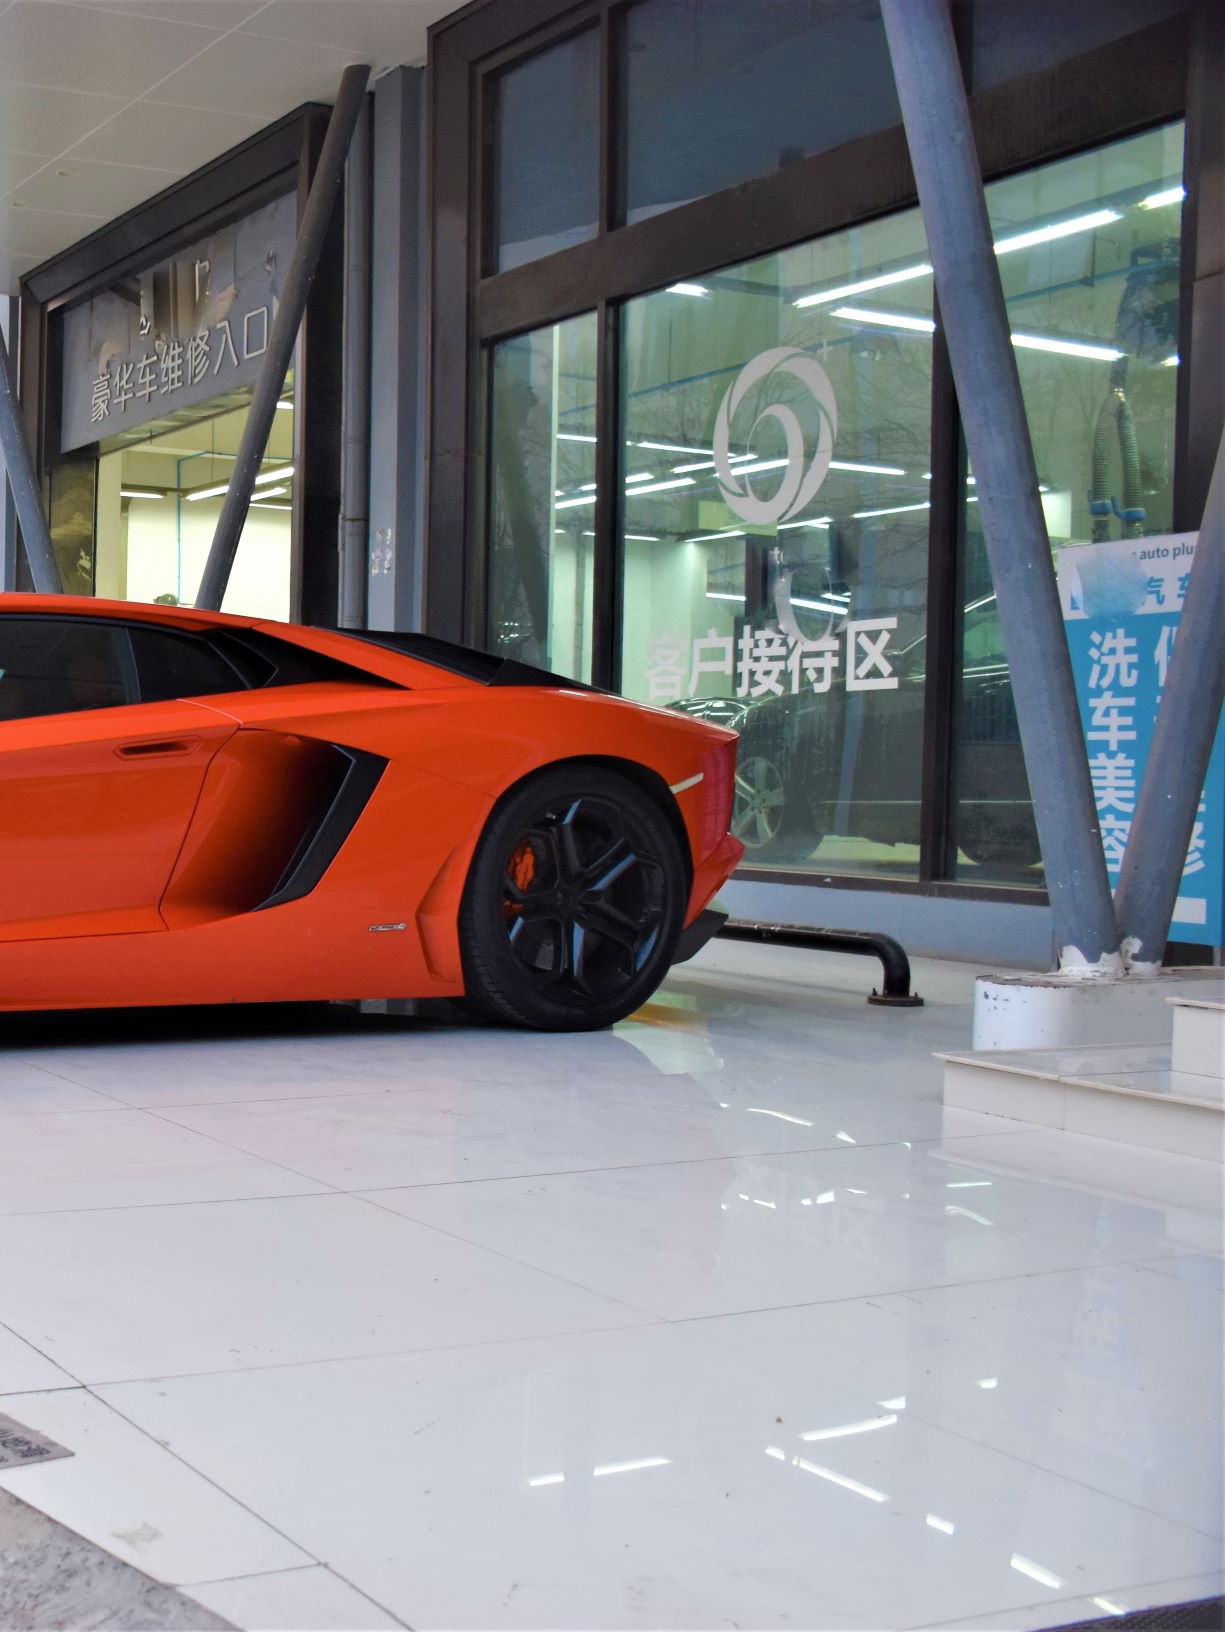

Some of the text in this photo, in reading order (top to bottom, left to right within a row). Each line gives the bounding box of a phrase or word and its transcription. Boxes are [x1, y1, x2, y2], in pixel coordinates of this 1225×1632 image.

[91, 305, 268, 422] 豪华车维修入口
[1139, 542, 1196, 560] auto plu
[645, 617, 899, 700] 客户接待区
